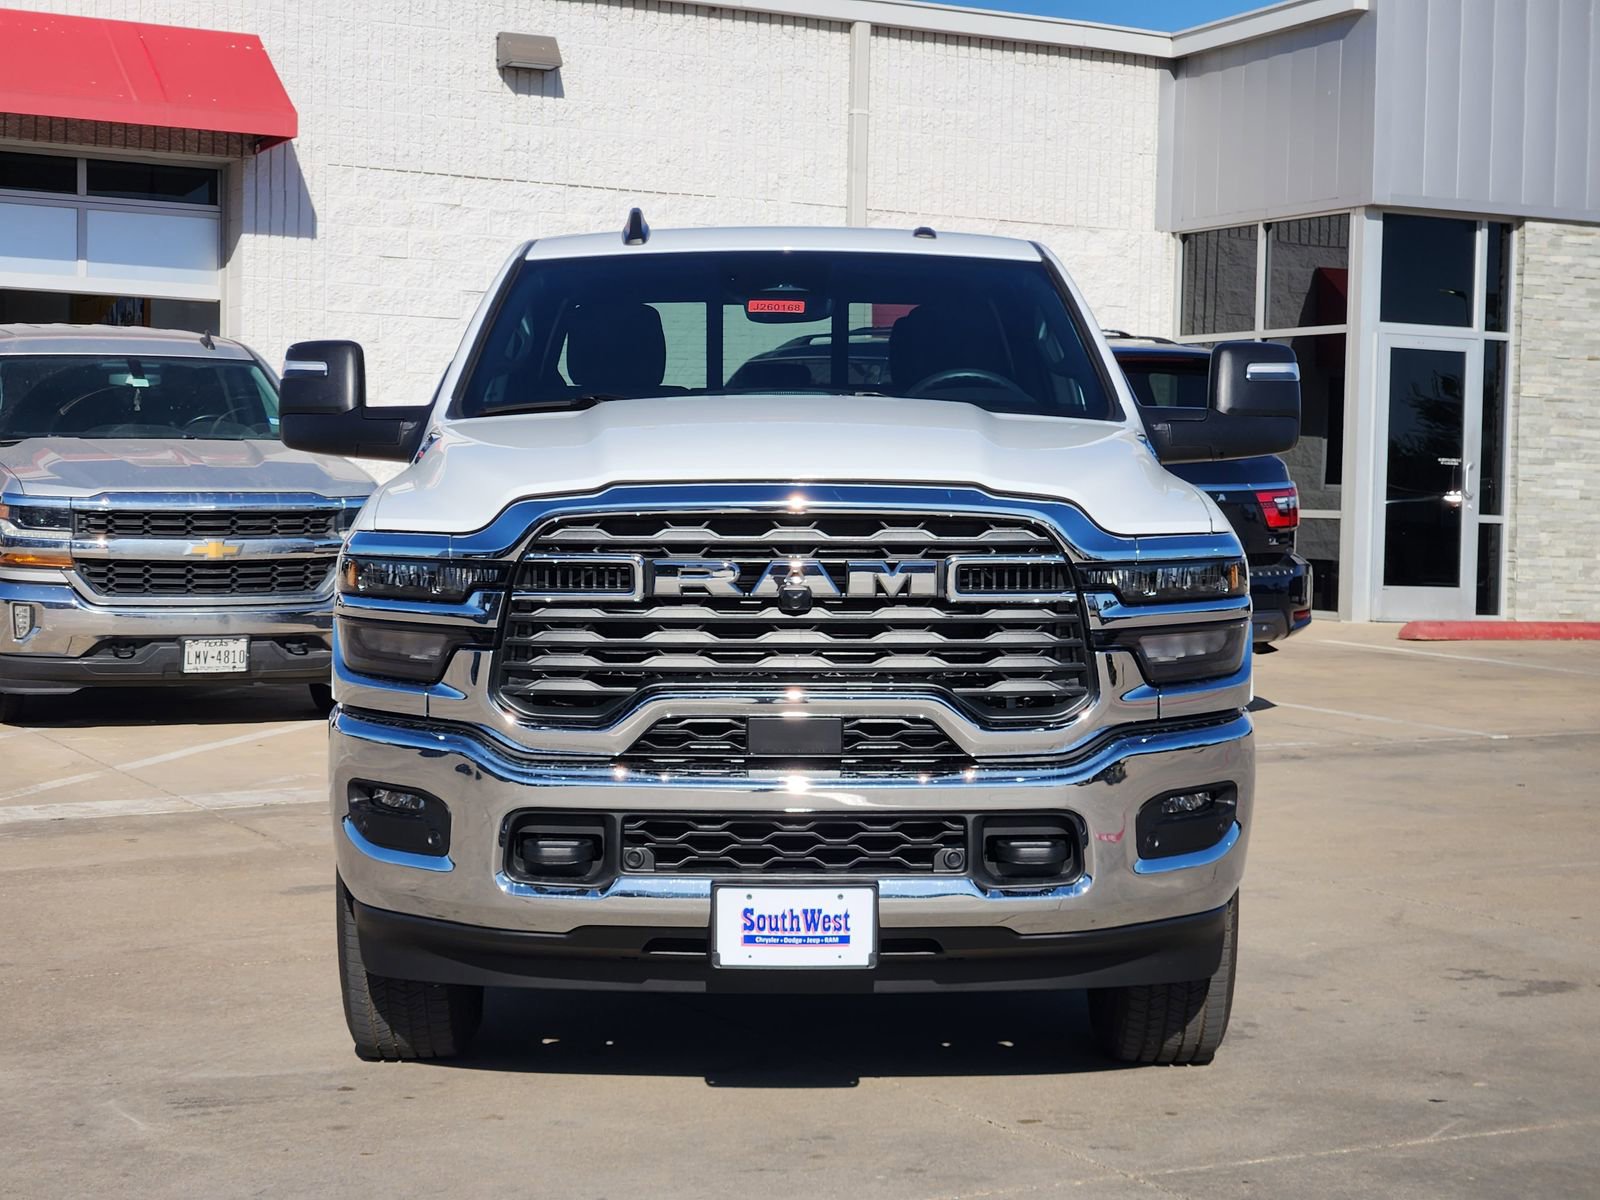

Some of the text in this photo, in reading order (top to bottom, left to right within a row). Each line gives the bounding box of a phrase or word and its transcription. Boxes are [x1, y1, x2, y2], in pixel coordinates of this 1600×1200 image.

[752, 303, 801, 312] J260168
[652, 559, 938, 597] RAM
[742, 907, 851, 933] SouthWest
[755, 936, 840, 945] Chrysler Dodge Jeep RAM
